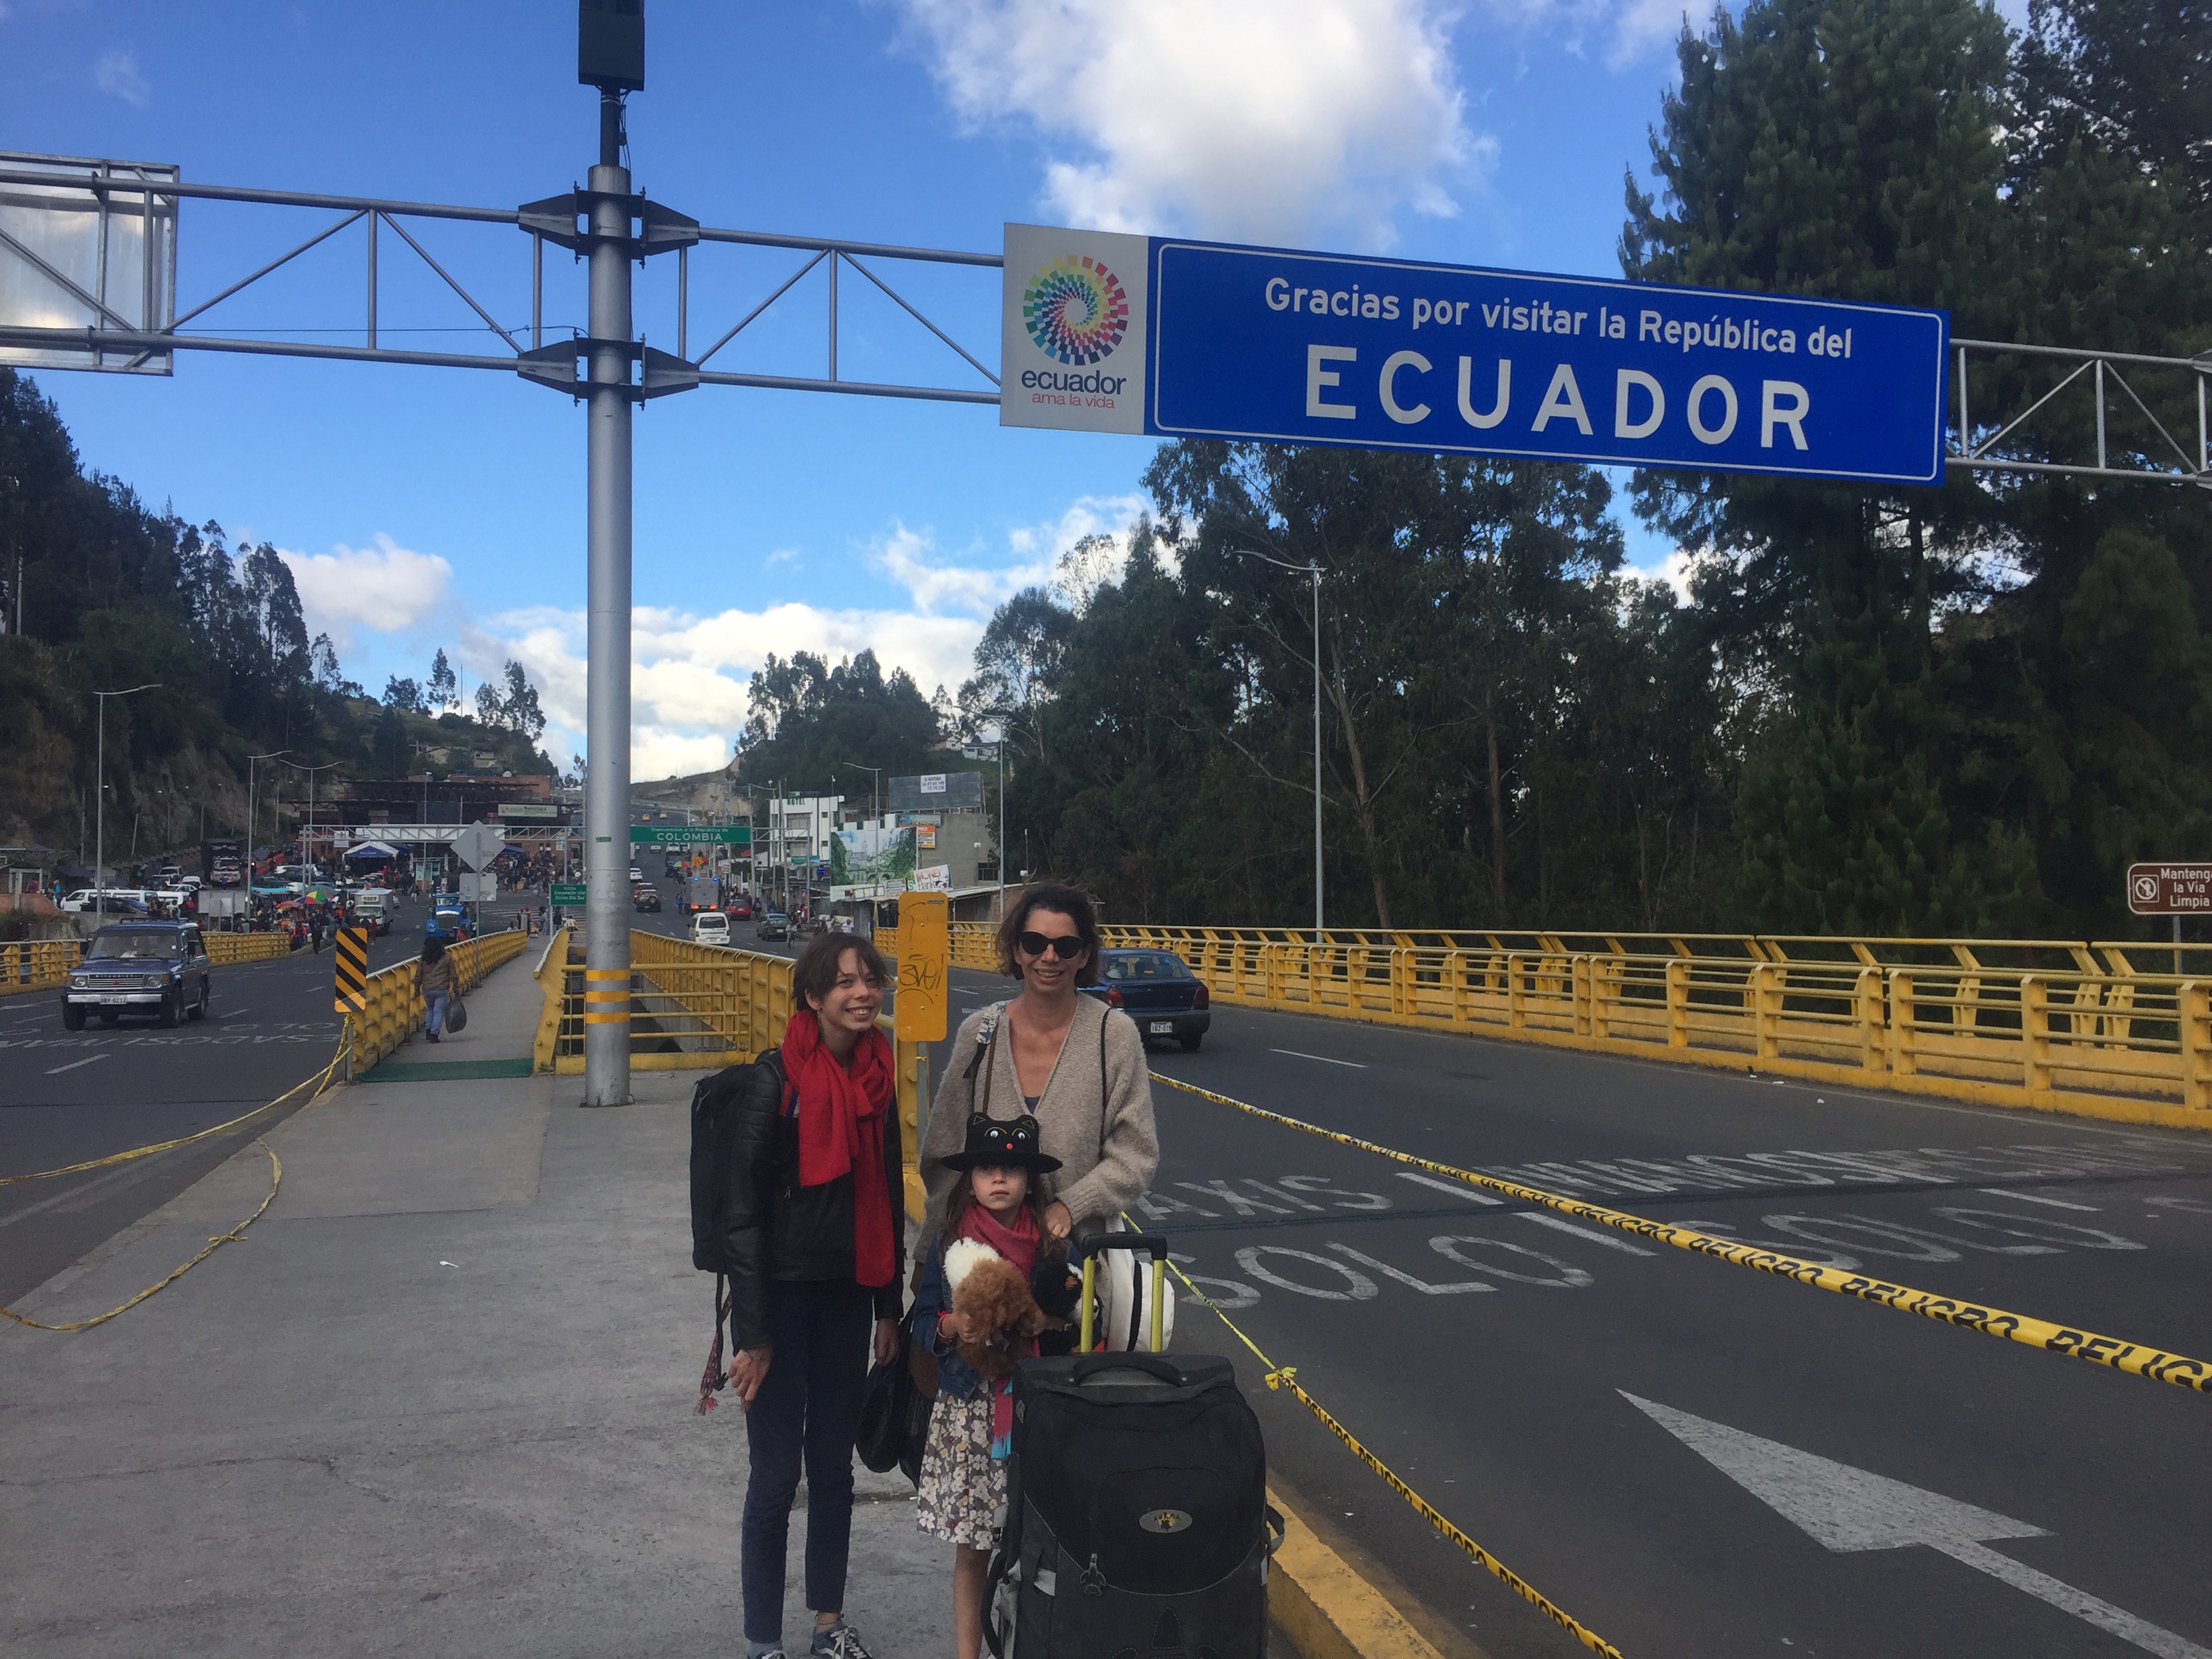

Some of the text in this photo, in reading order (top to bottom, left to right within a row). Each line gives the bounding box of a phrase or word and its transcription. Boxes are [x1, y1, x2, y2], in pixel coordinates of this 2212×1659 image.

[1265, 277, 1852, 359] Gracias por visitar la República del
[1021, 370, 1126, 394] ecuador
[1031, 393, 1115, 409] ama la vida
[1306, 344, 1810, 451] ECUADOR
[657, 833, 723, 841] COLOMBIA
[2160, 868, 2212, 883] Manteng
[2173, 880, 2205, 893] la Vía
[2170, 895, 2210, 909] Limpia
